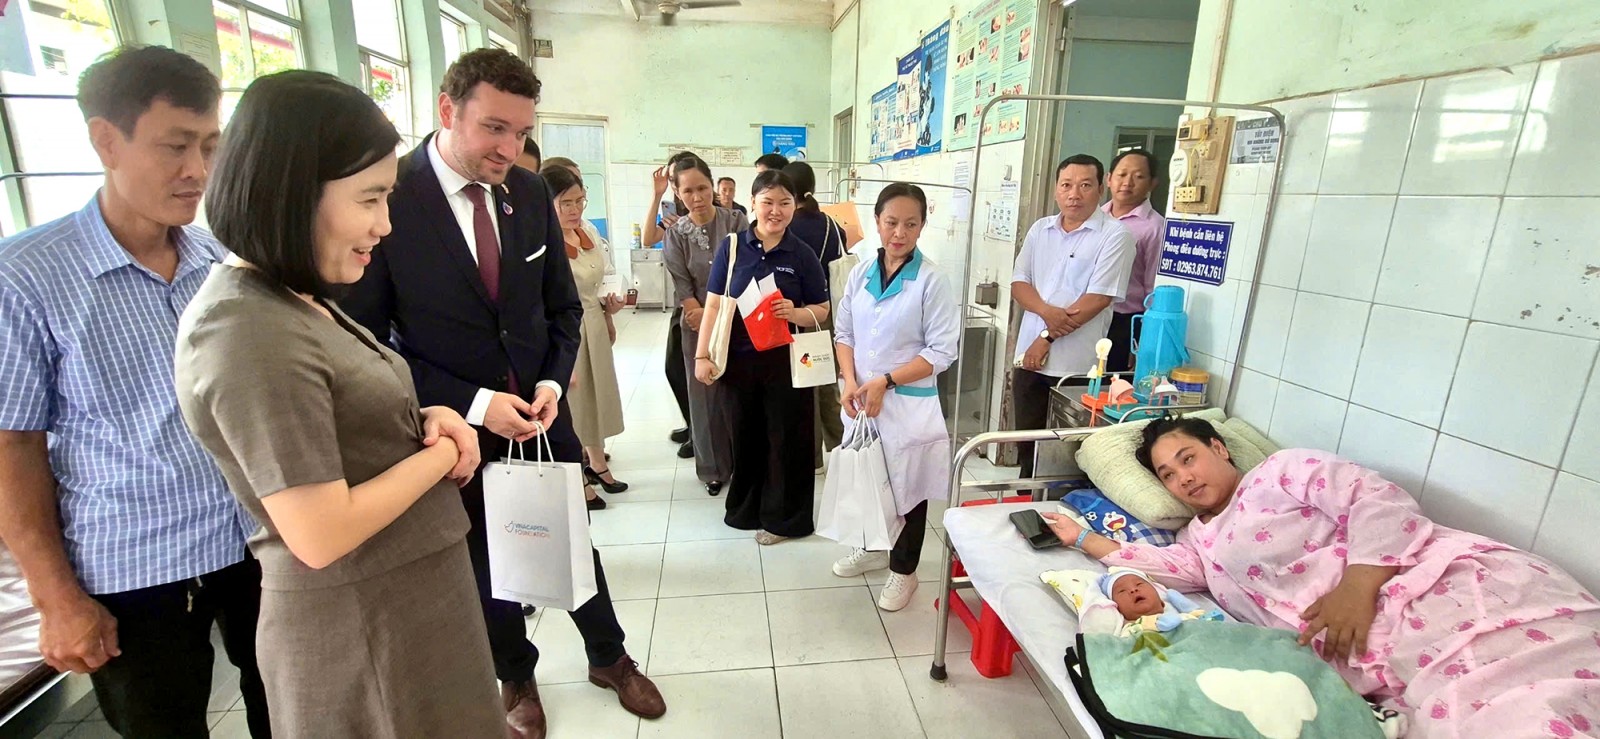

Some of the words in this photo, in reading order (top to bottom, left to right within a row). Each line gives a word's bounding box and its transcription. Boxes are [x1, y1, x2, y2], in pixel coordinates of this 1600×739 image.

[1169, 226, 1180, 237] Khi
[1179, 227, 1193, 240] bệnh
[1204, 229, 1216, 241] liên
[1216, 231, 1225, 245] hệ
[1163, 241, 1180, 255] Phòng
[1192, 244, 1209, 259] dưỡng
[1209, 247, 1222, 260] trực
[1161, 258, 1173, 271] SĐT
[1176, 260, 1222, 280] 02963.874.761
